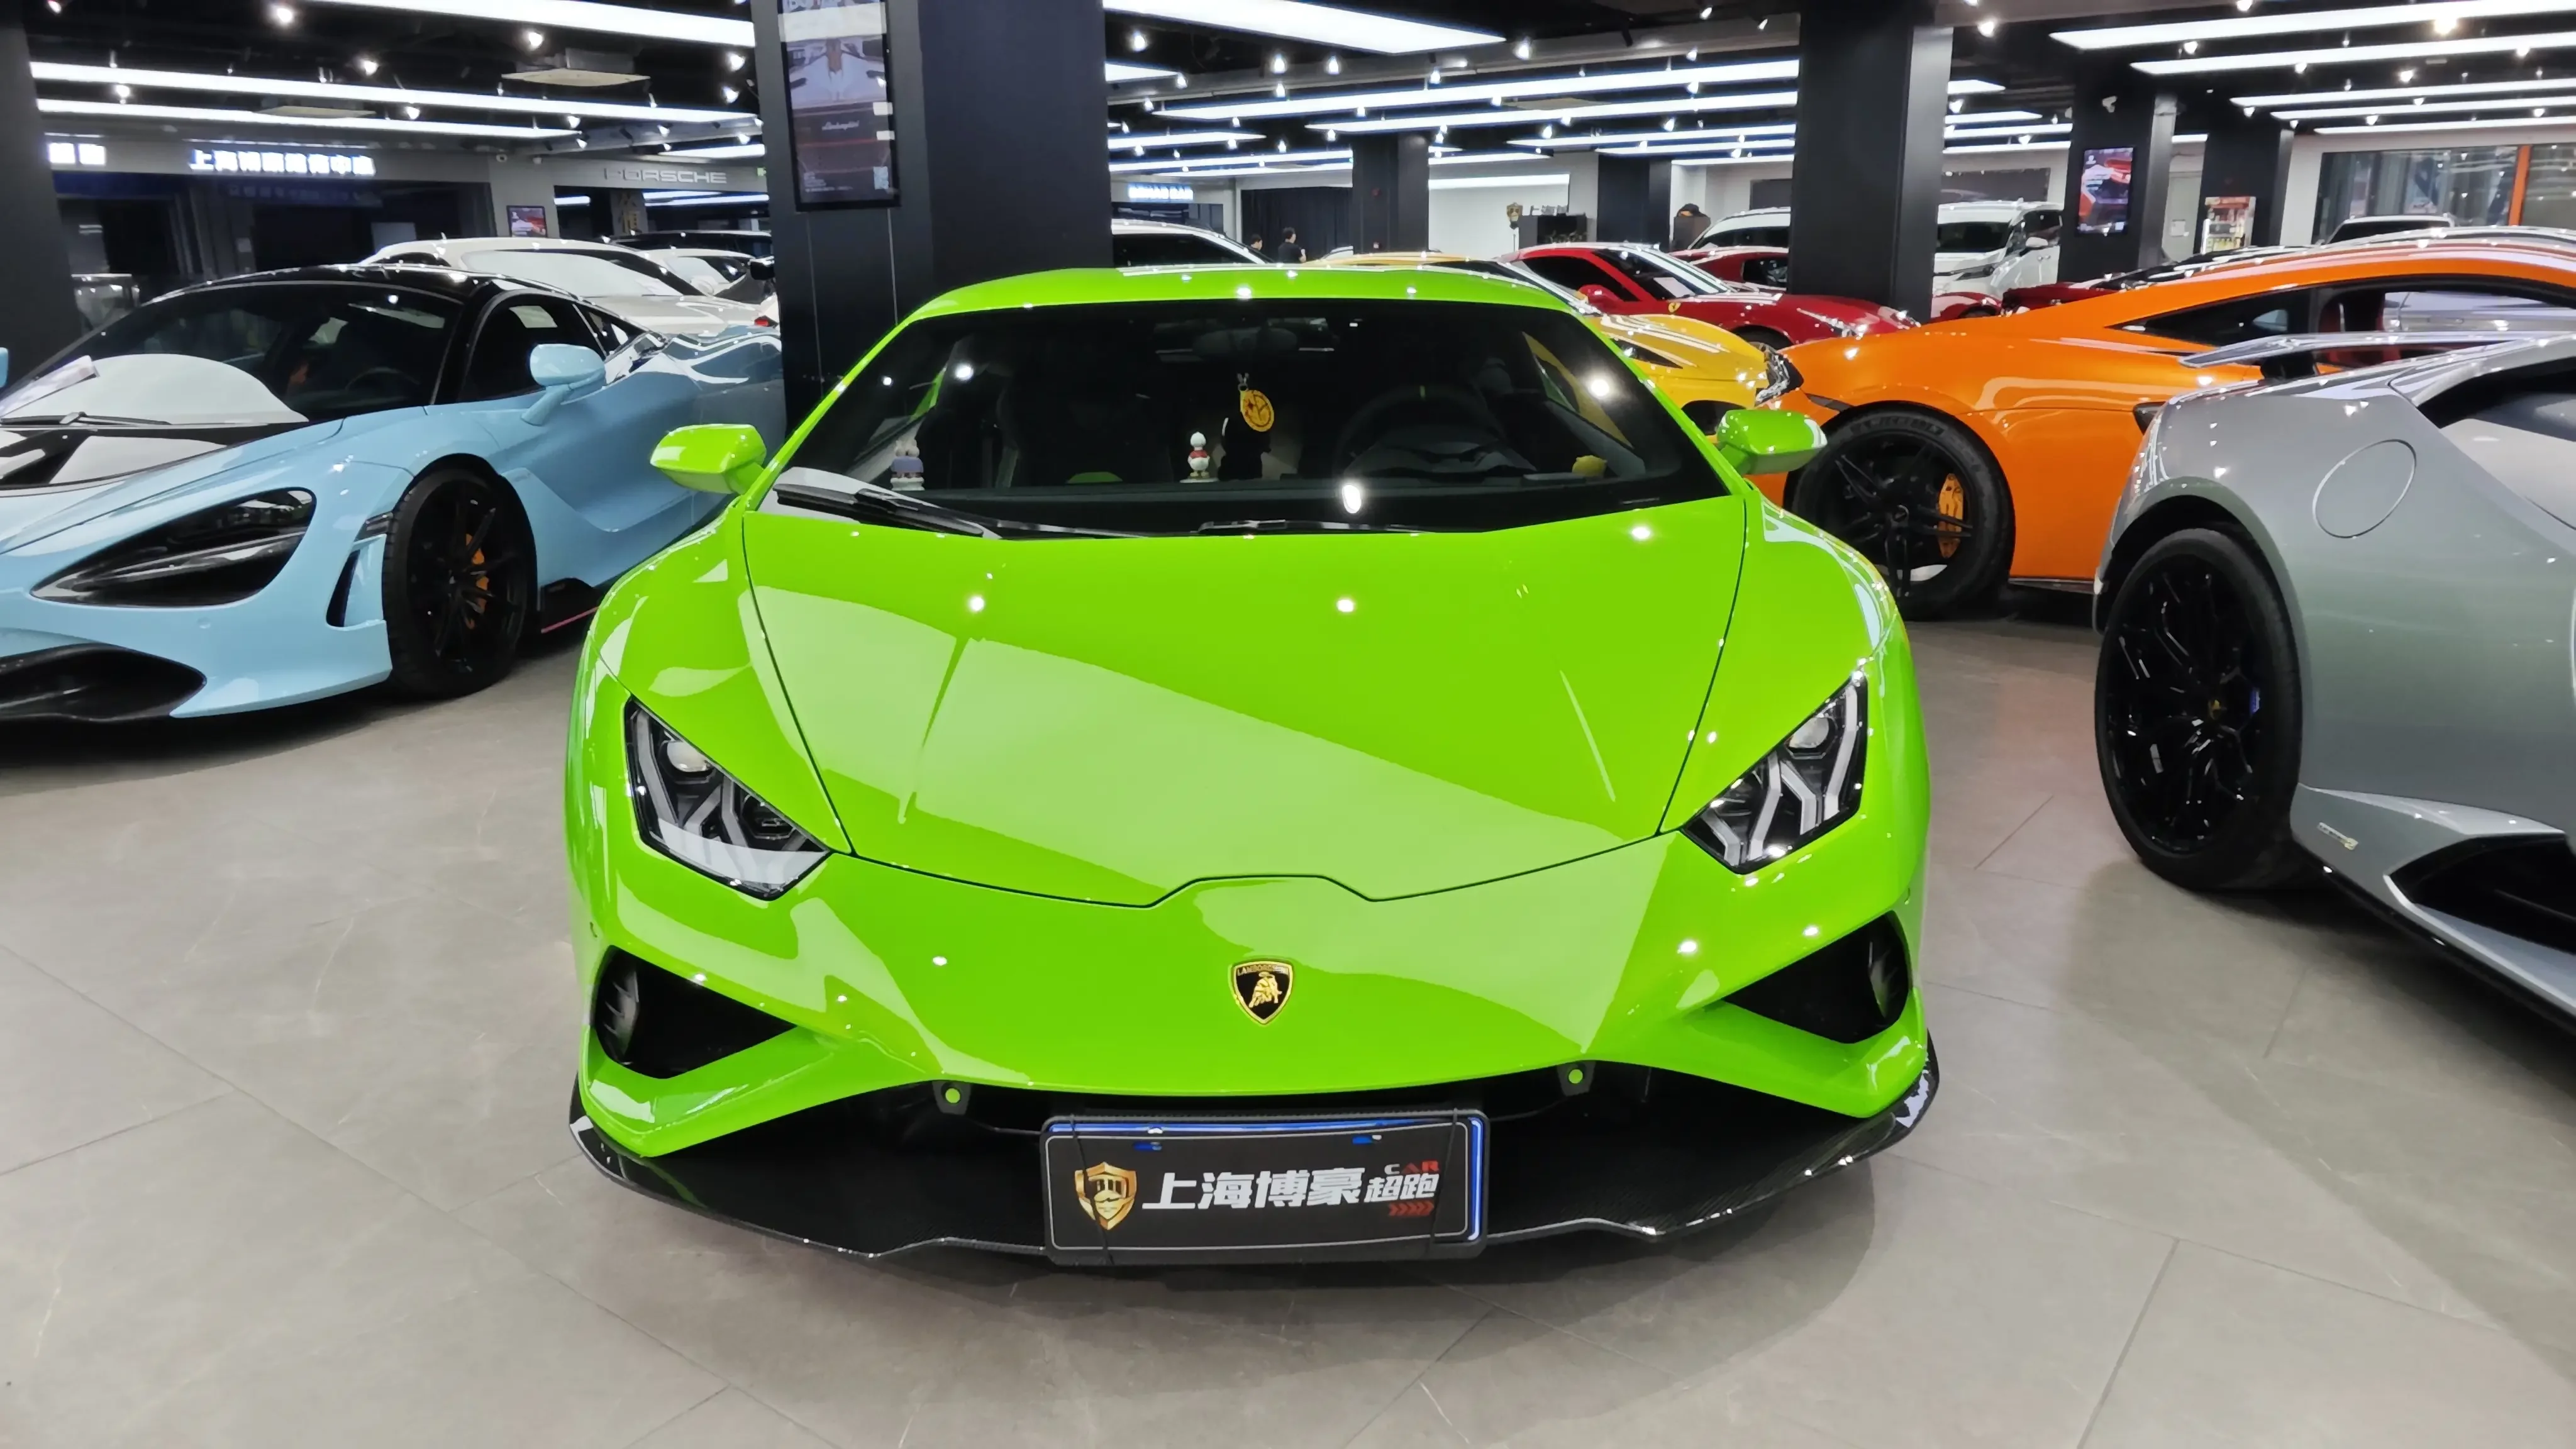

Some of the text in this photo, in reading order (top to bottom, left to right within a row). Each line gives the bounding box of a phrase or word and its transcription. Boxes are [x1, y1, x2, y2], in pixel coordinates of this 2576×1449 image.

[604, 168, 727, 184] PORSCHE
[1384, 1160, 1440, 1175] CAR
[1141, 1167, 1440, 1209] 上海博豪 超跑
